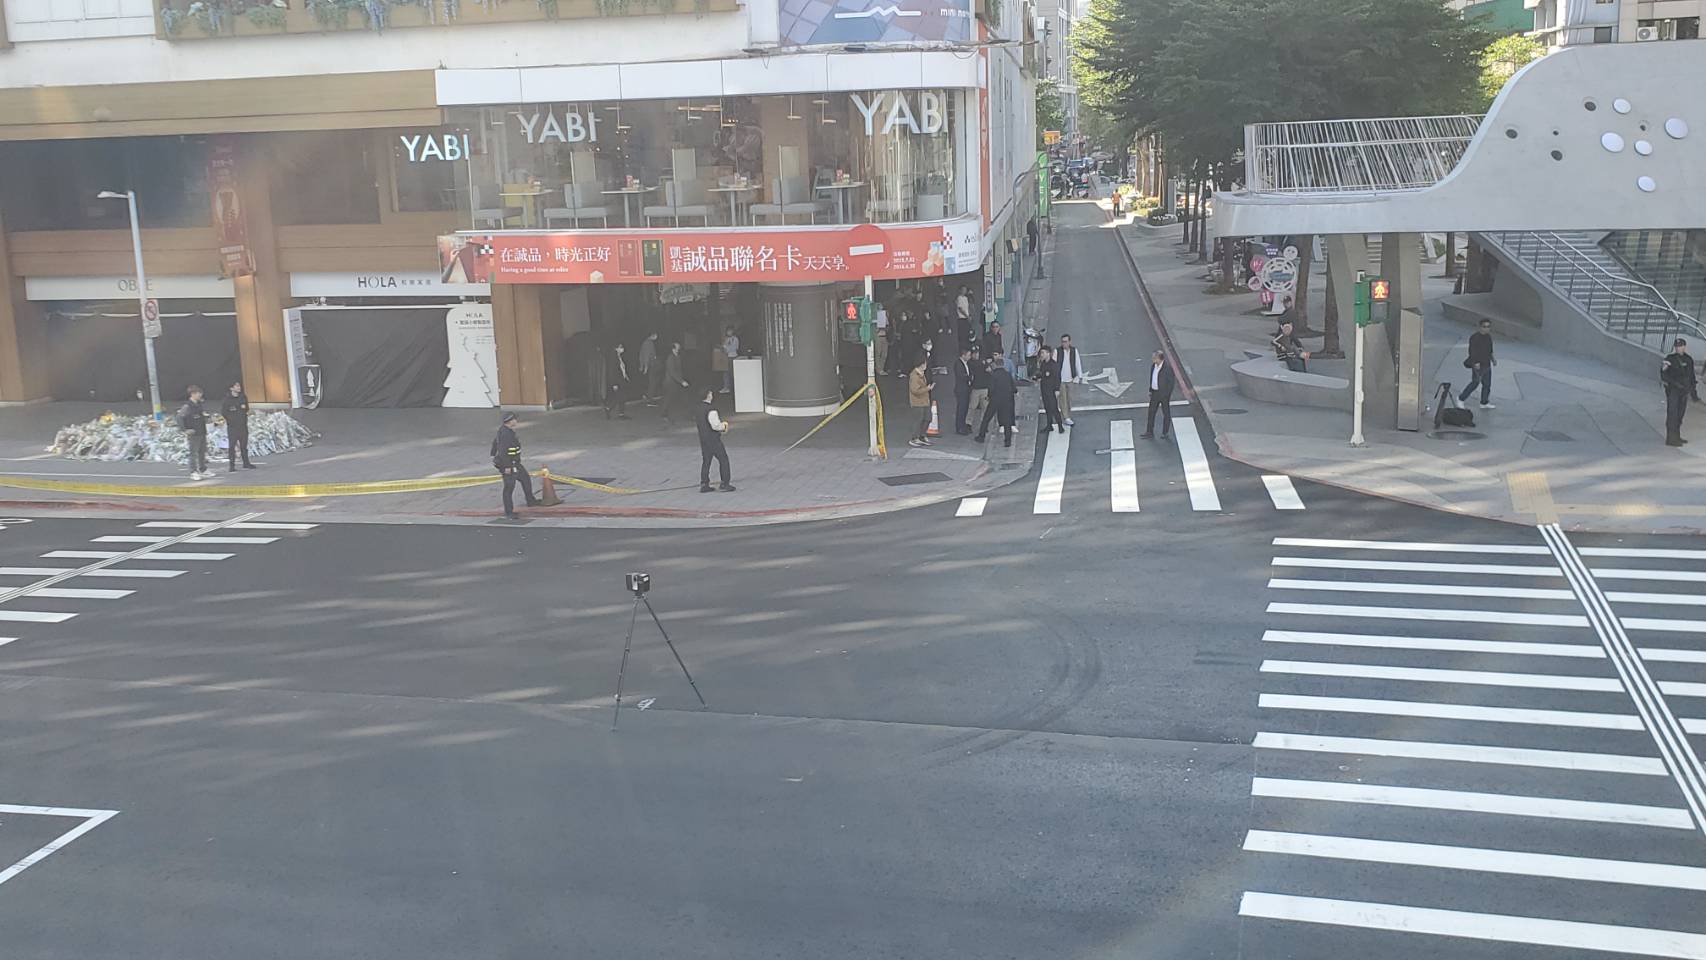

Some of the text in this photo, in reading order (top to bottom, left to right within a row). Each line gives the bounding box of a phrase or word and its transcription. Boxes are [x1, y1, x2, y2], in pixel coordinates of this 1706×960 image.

[849, 89, 949, 136] YABI
[516, 111, 597, 144] YABI
[400, 133, 470, 162] YABI
[669, 244, 846, 273] 凱基 誠品聯名卡 天天享
[118, 279, 153, 292] OBE
[357, 276, 398, 289] HOLA
